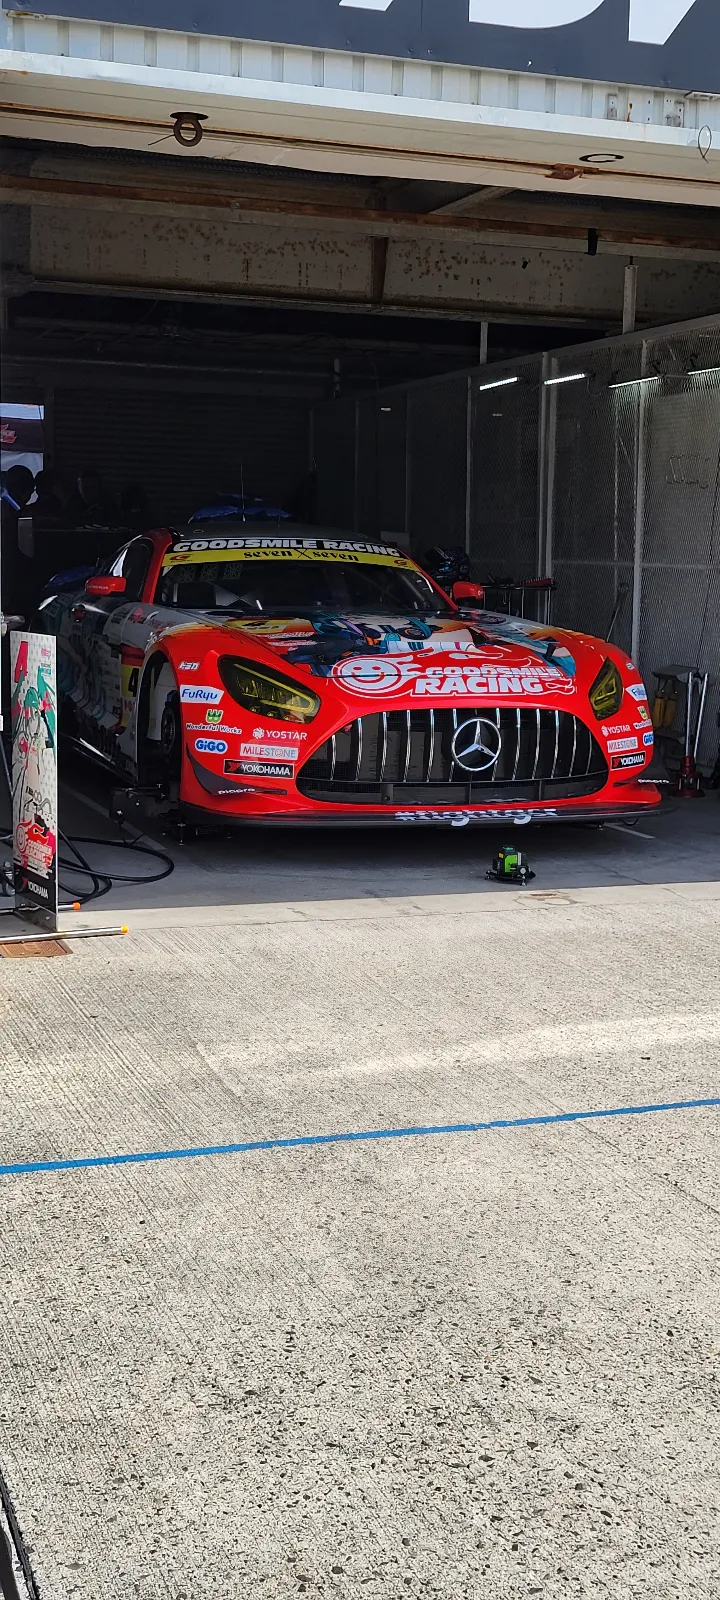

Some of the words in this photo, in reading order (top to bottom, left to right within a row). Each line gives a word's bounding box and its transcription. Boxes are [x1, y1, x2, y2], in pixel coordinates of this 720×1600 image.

[173, 539, 316, 552] GOODSMILE
[323, 540, 400, 557] RACING
[243, 549, 293, 558] seven
[312, 550, 359, 562] seven
[426, 666, 562, 678] GOODSMILE
[415, 677, 543, 694] RACING
[181, 688, 218, 701] FuRyu
[186, 722, 219, 732] Wonderful
[219, 725, 242, 735] Works
[266, 730, 307, 740] YOSTAR
[607, 724, 631, 734] YOSTAR
[242, 745, 296, 758] MILESTONE
[241, 763, 291, 776] YOKOHAMA
